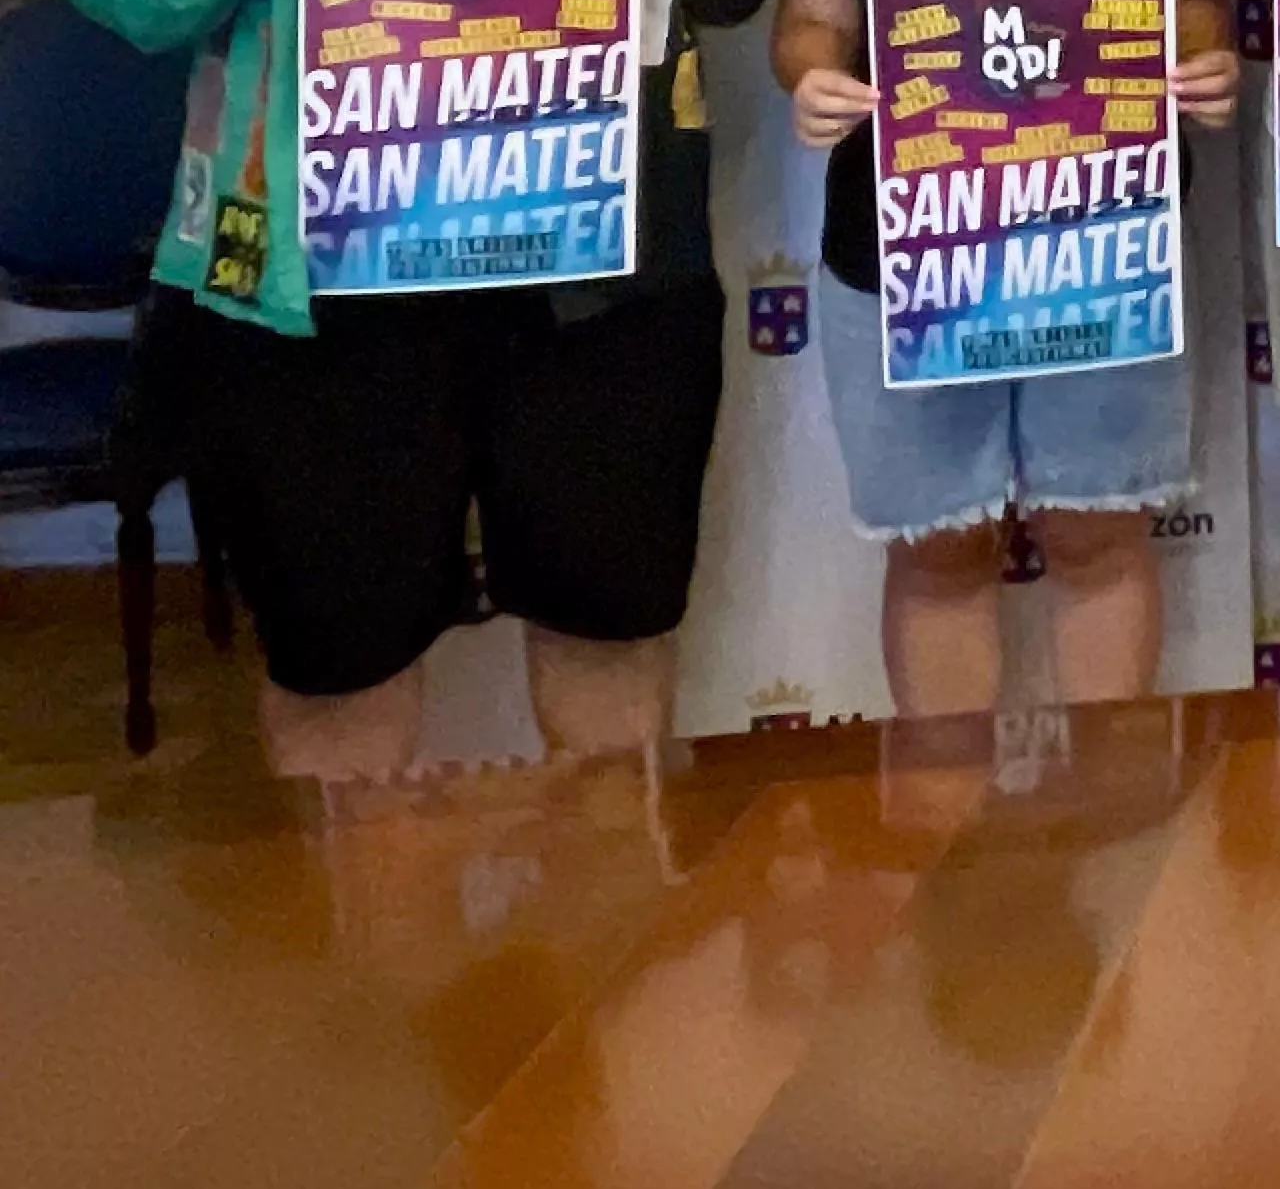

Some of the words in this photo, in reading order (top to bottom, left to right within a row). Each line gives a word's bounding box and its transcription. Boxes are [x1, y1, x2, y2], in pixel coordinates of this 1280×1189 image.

[982, 38, 1060, 90] QD!
[983, 5, 1025, 45] M
[303, 62, 422, 138] SAN
[437, 41, 631, 126] MATEO
[302, 142, 421, 218] SAN
[436, 116, 627, 205] MATEO
[880, 166, 985, 239] SAN
[999, 139, 1170, 227] MATEO
[884, 243, 986, 315] SAN
[1002, 212, 1172, 300] MATEO
[1149, 506, 1214, 538] zón
